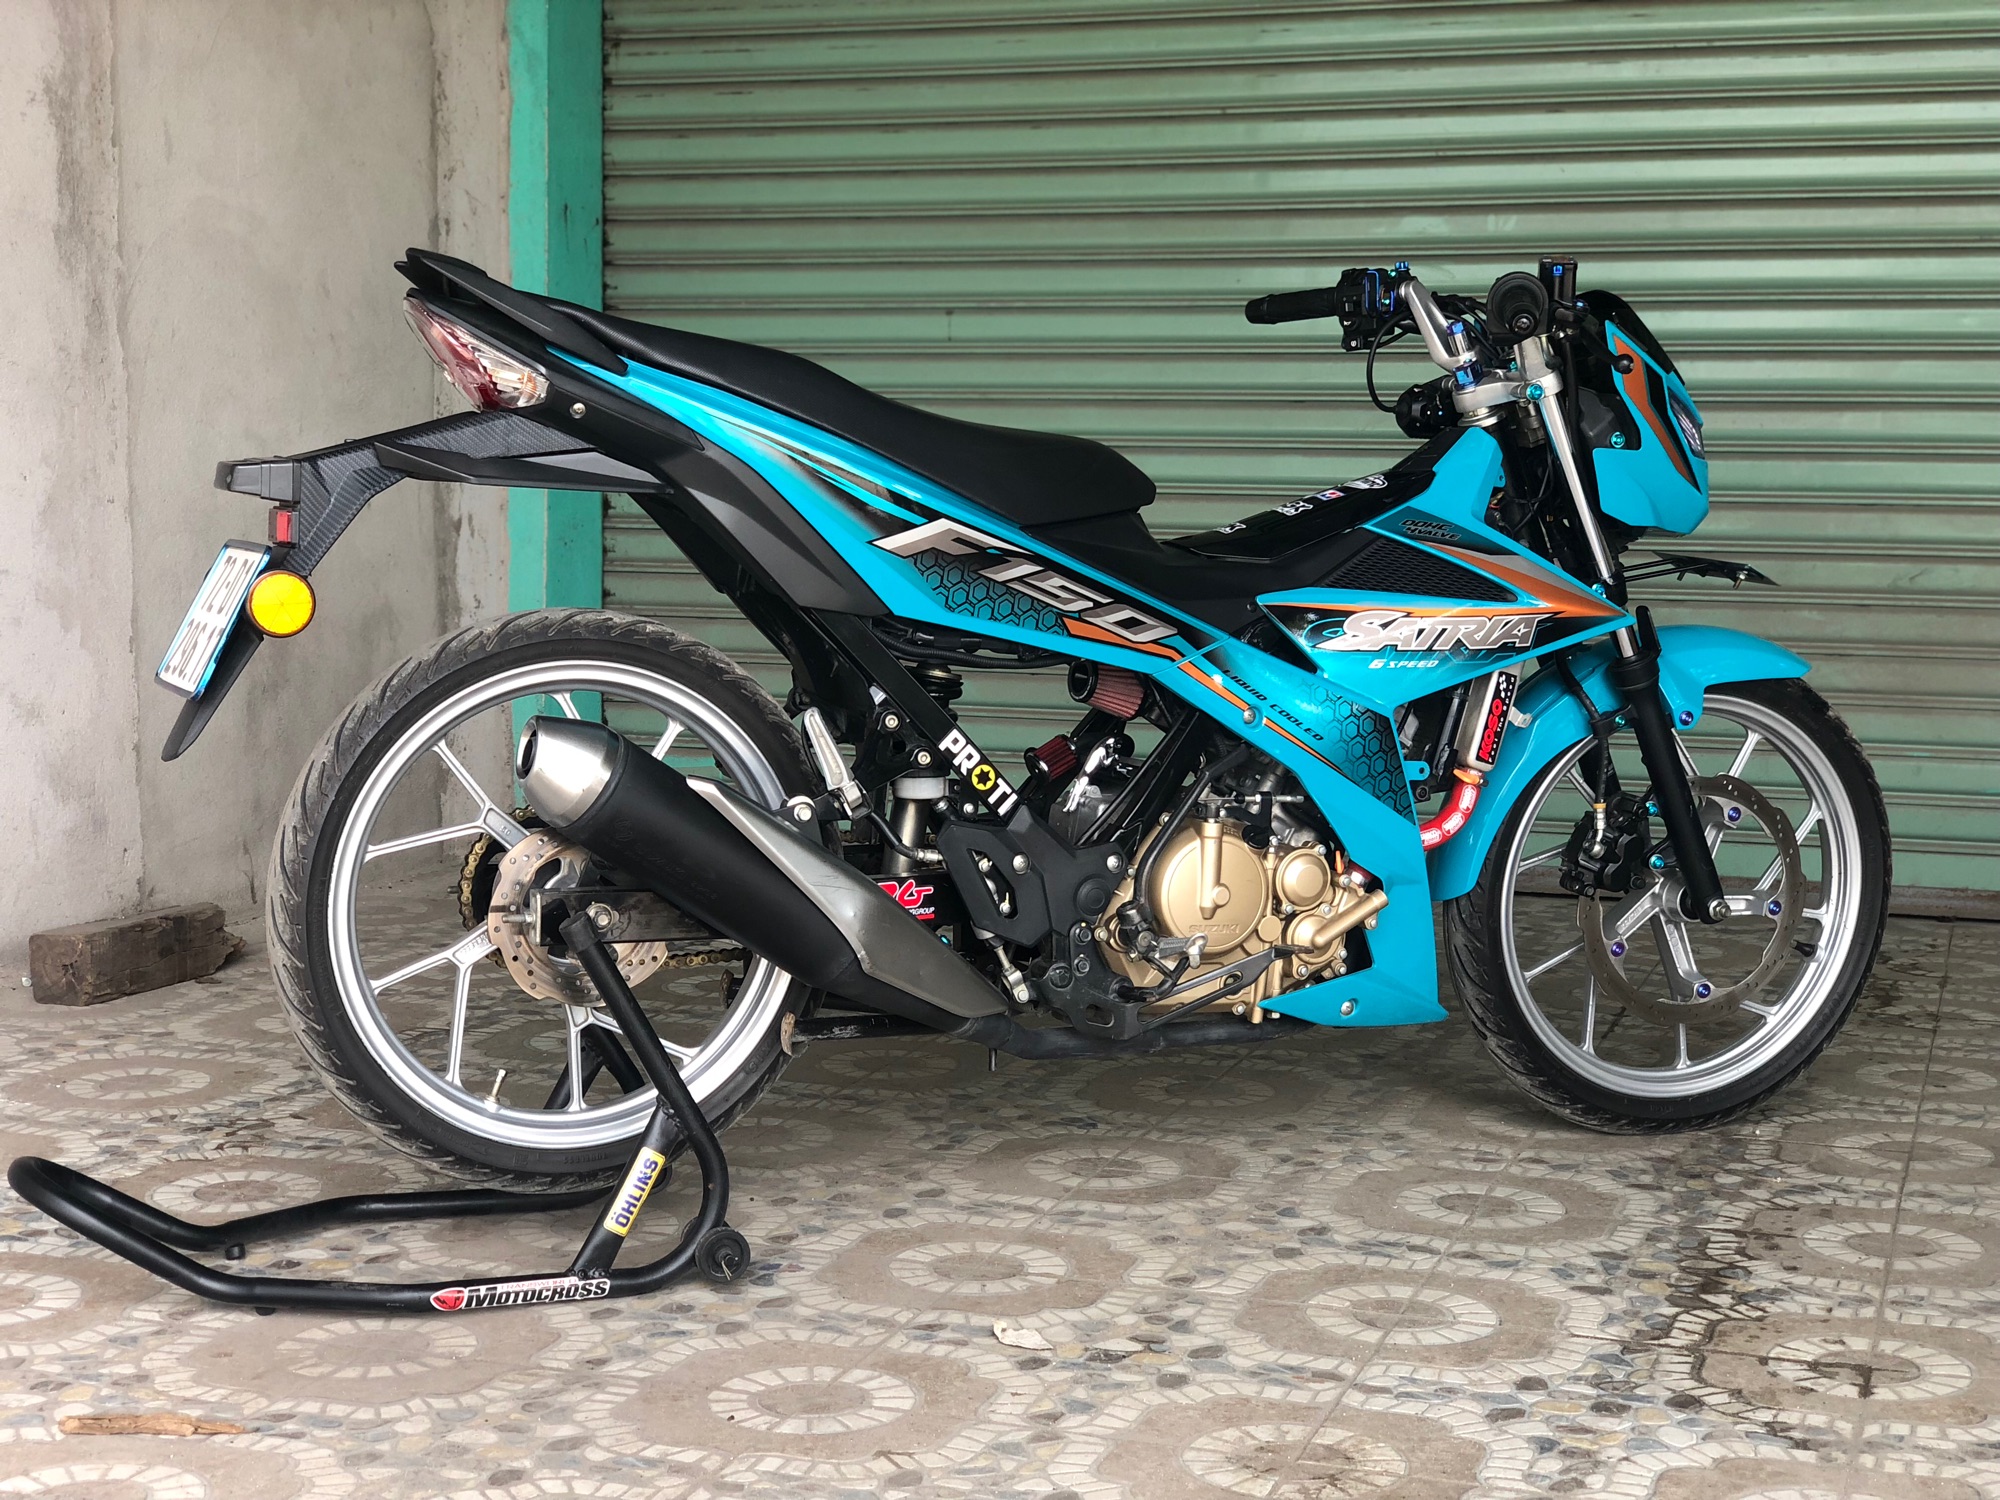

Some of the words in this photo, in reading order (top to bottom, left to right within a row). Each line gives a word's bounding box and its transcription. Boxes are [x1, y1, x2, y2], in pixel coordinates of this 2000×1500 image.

[1400, 519, 1454, 532] DOHC
[1314, 610, 1554, 651] SATRIA
[1368, 658, 1388, 669] 6
[1388, 659, 1440, 669] SPEED
[1222, 669, 1268, 701] LIQUID
[1269, 703, 1324, 741] COOLED
[1478, 698, 1503, 761] KOSO
[1188, 923, 1240, 934] SUZUKI
[464, 1280, 608, 1309] MOTOCROSS
